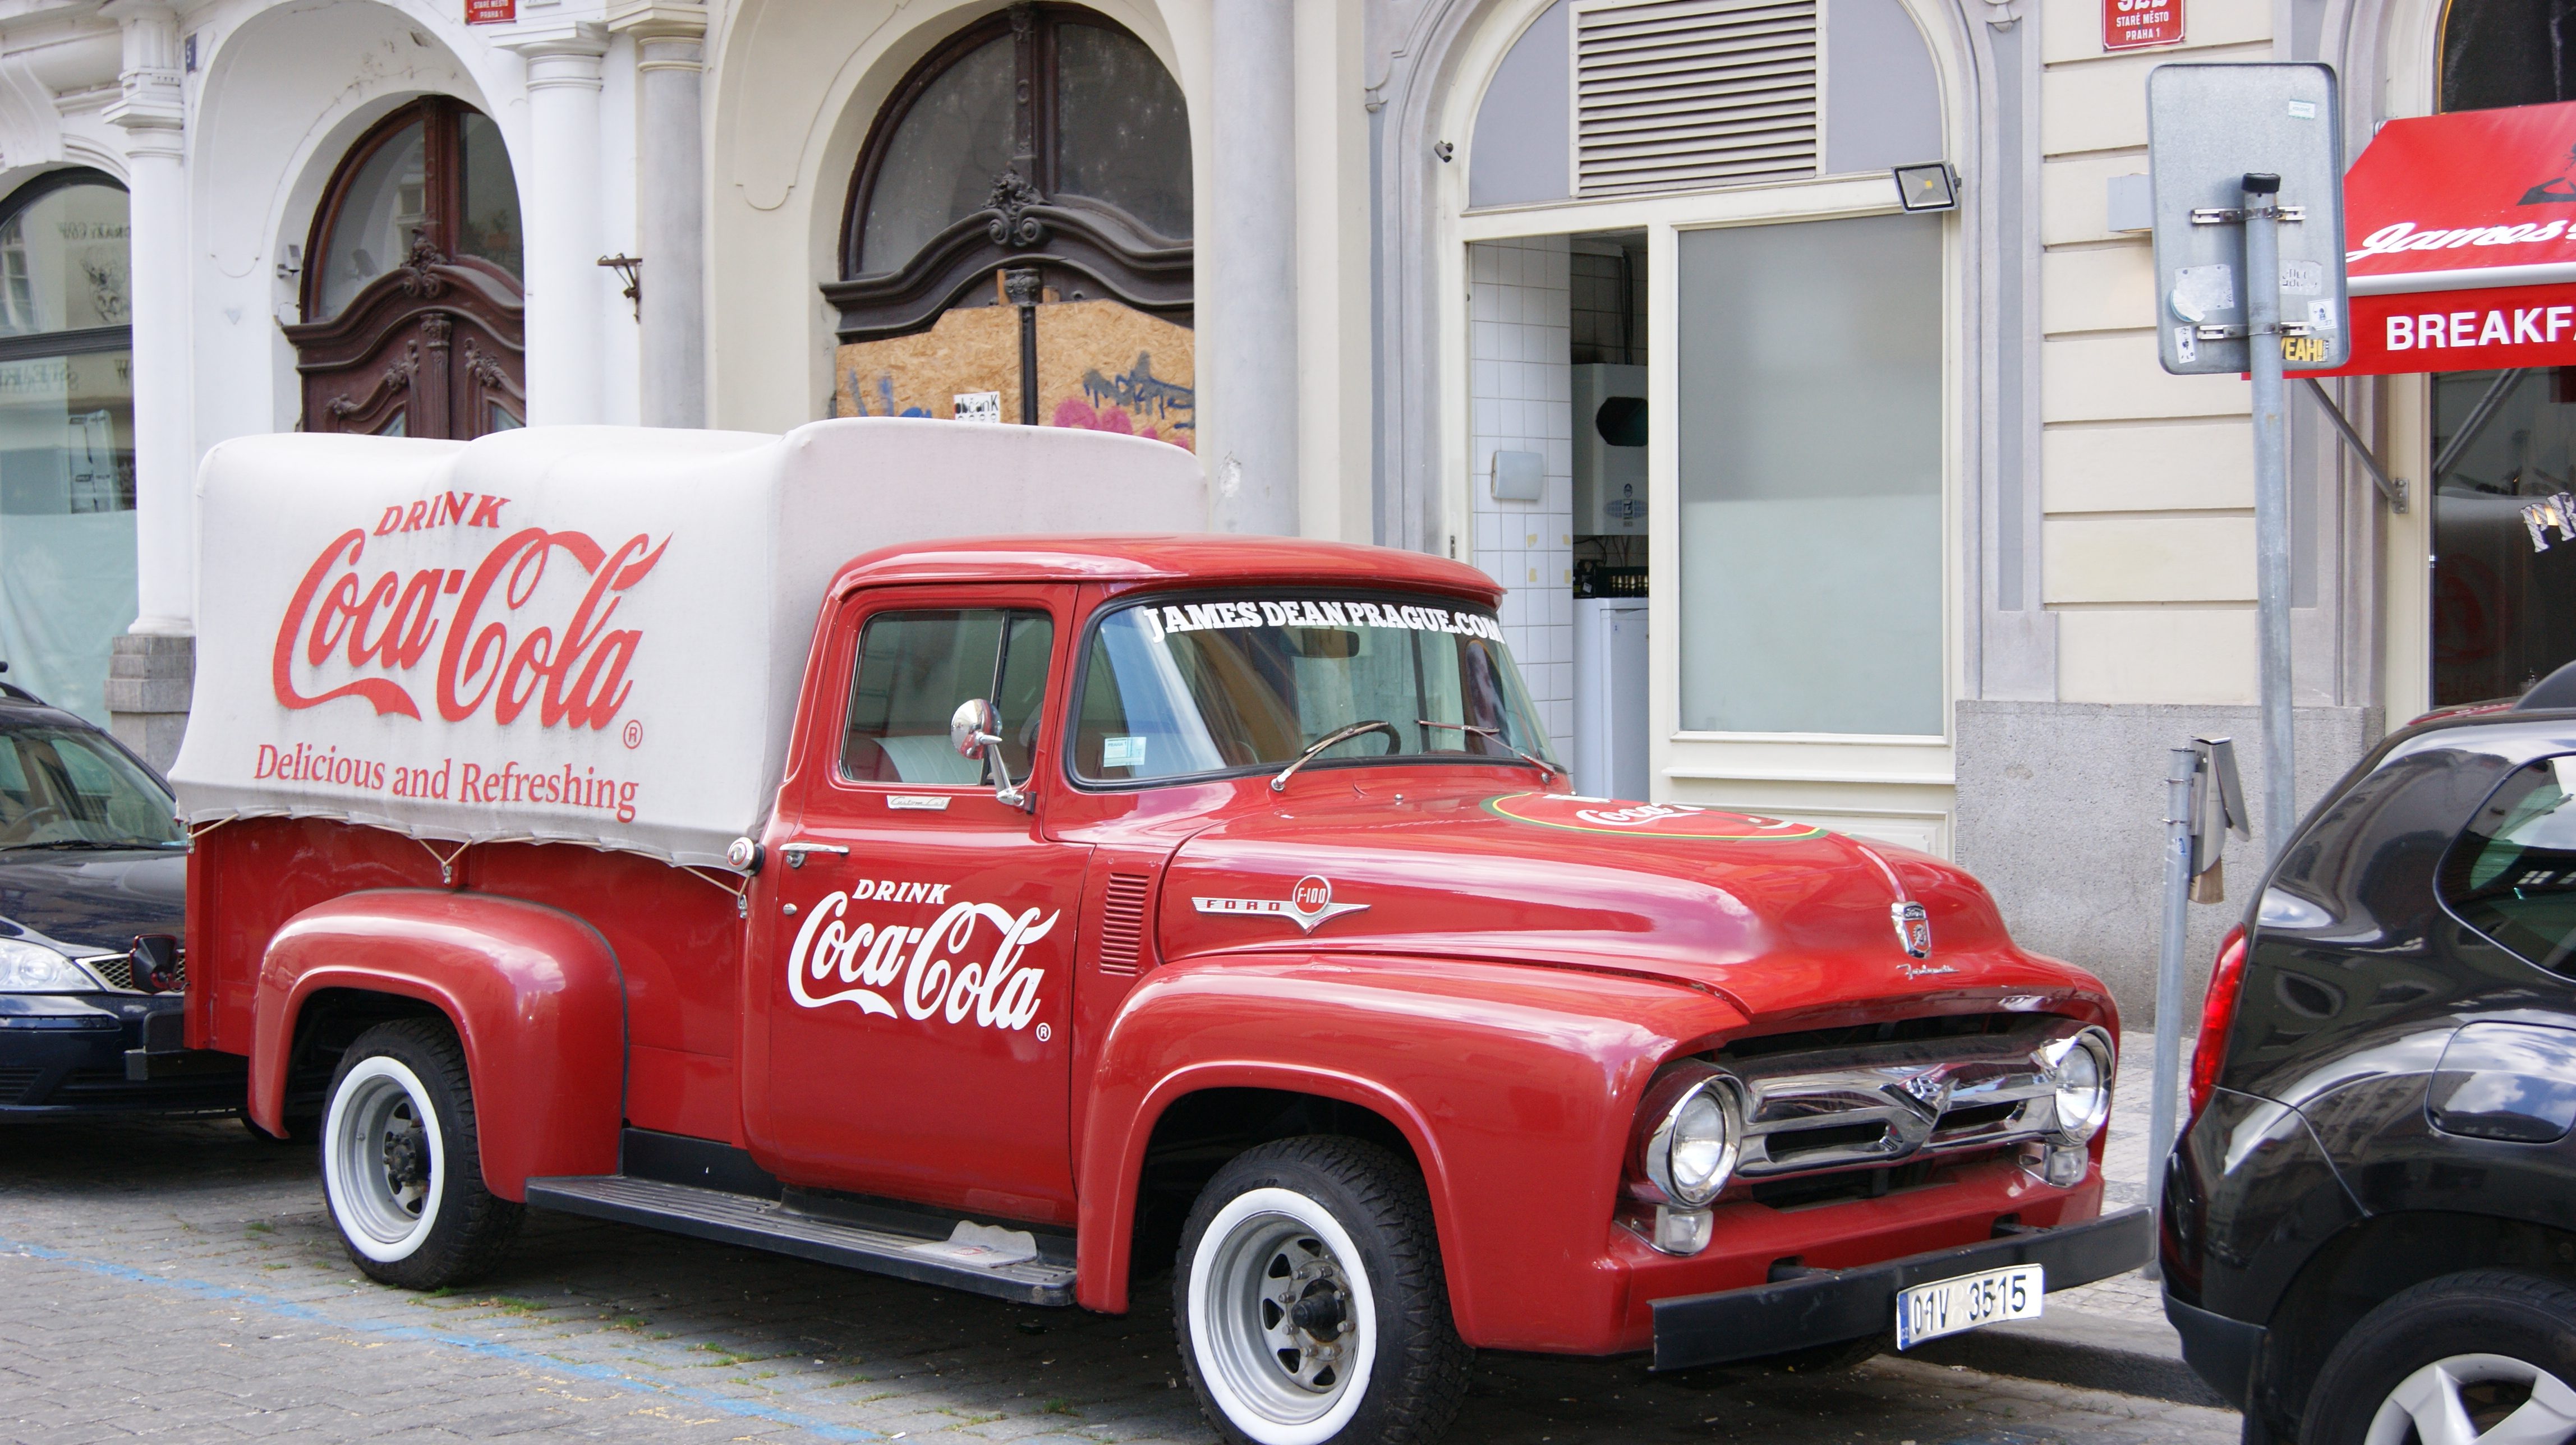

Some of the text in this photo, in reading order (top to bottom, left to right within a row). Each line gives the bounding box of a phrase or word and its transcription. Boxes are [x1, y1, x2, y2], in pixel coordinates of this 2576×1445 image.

[2116, 11, 2169, 27] STARÉ MĚSTO
[2126, 27, 2160, 41] PRAHA 1
[2386, 305, 2576, 351] BREAKF
[373, 491, 511, 536] DRINK
[273, 526, 674, 730] Coca-Cola
[254, 742, 639, 823] Delicious and Refreshing
[852, 879, 951, 904] DRINK
[1206, 899, 1281, 911] FORD
[788, 891, 1061, 1030] Coca-Cola
[1911, 1274, 2026, 1335] 01V 3515
